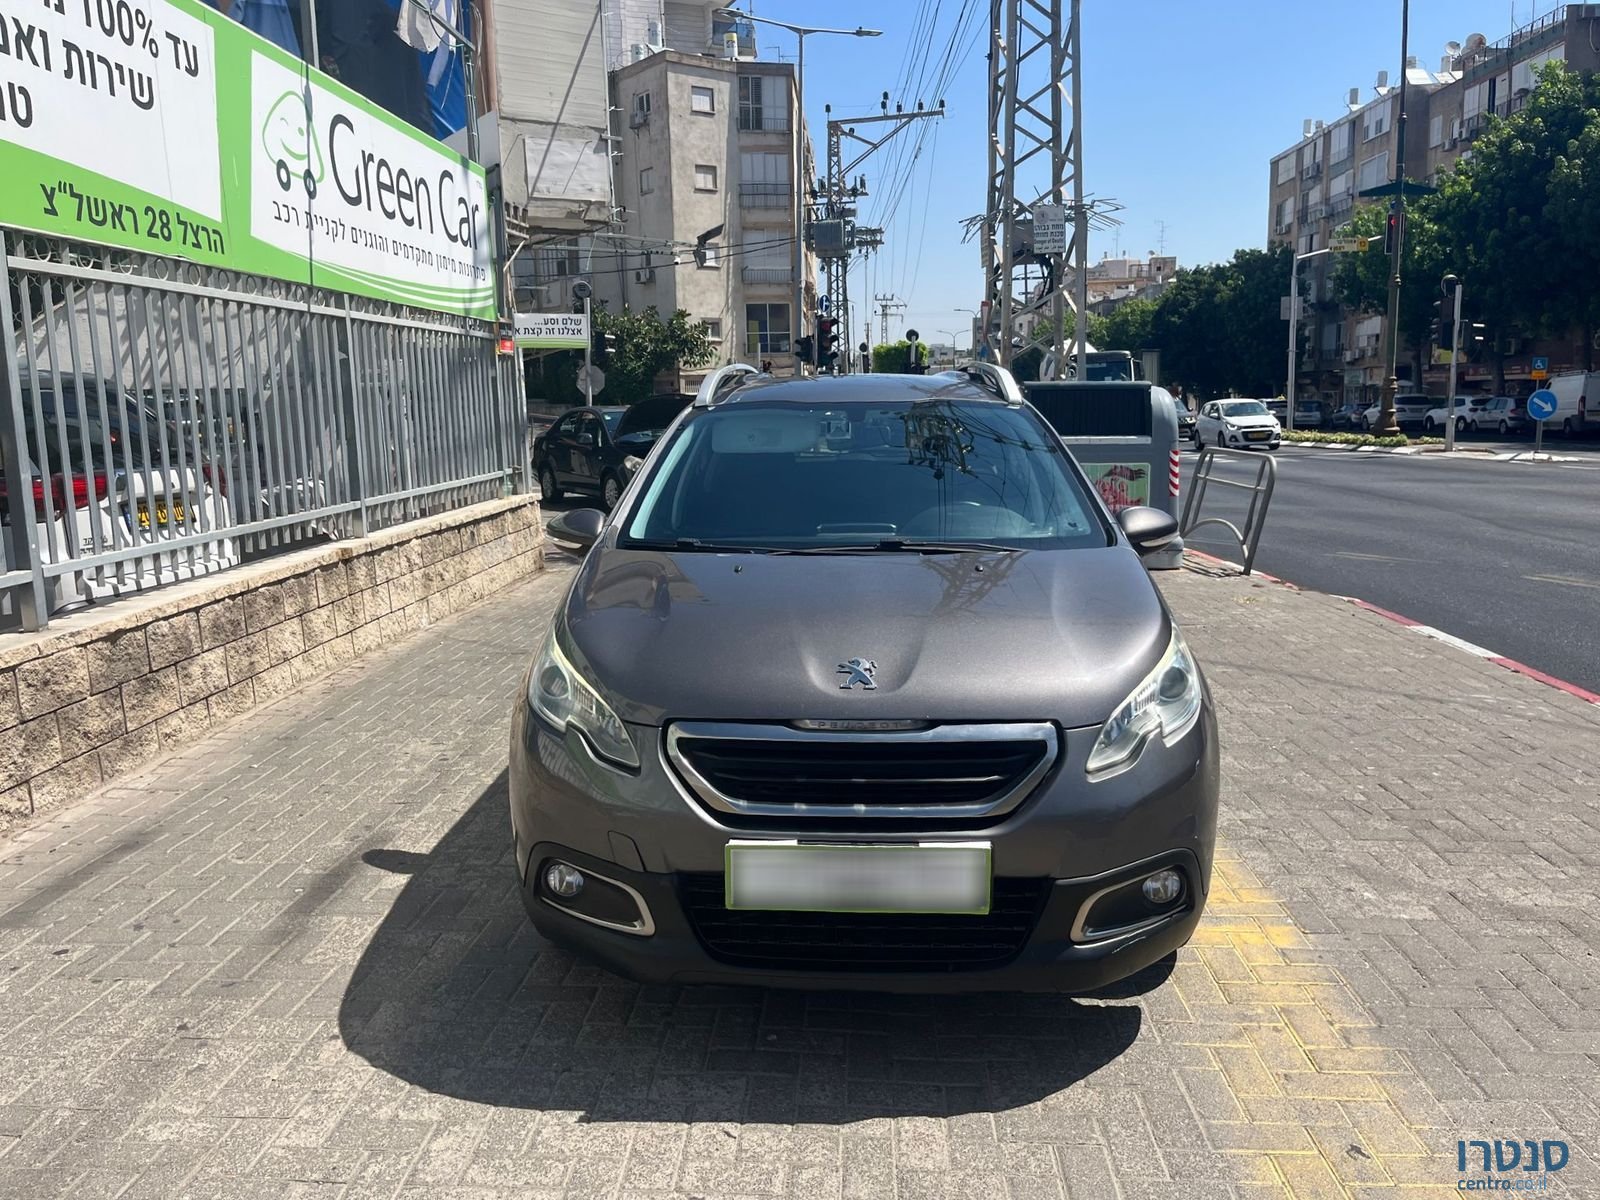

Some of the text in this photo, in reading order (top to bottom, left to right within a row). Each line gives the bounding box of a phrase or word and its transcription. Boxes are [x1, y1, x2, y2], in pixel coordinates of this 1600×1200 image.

[62, 39, 154, 110] שירות
[165, 31, 199, 78] עד
[328, 113, 480, 250] Green Car
[144, 205, 172, 242] 28
[176, 211, 225, 255] הרצל
[273, 200, 486, 281] פתרונות מימון מתקדמים והוגנים לקניית רכב
[523, 327, 543, 336] קצת
[545, 327, 556, 335] זה
[558, 326, 582, 335] אצלנו
[562, 317, 582, 326] שלם
